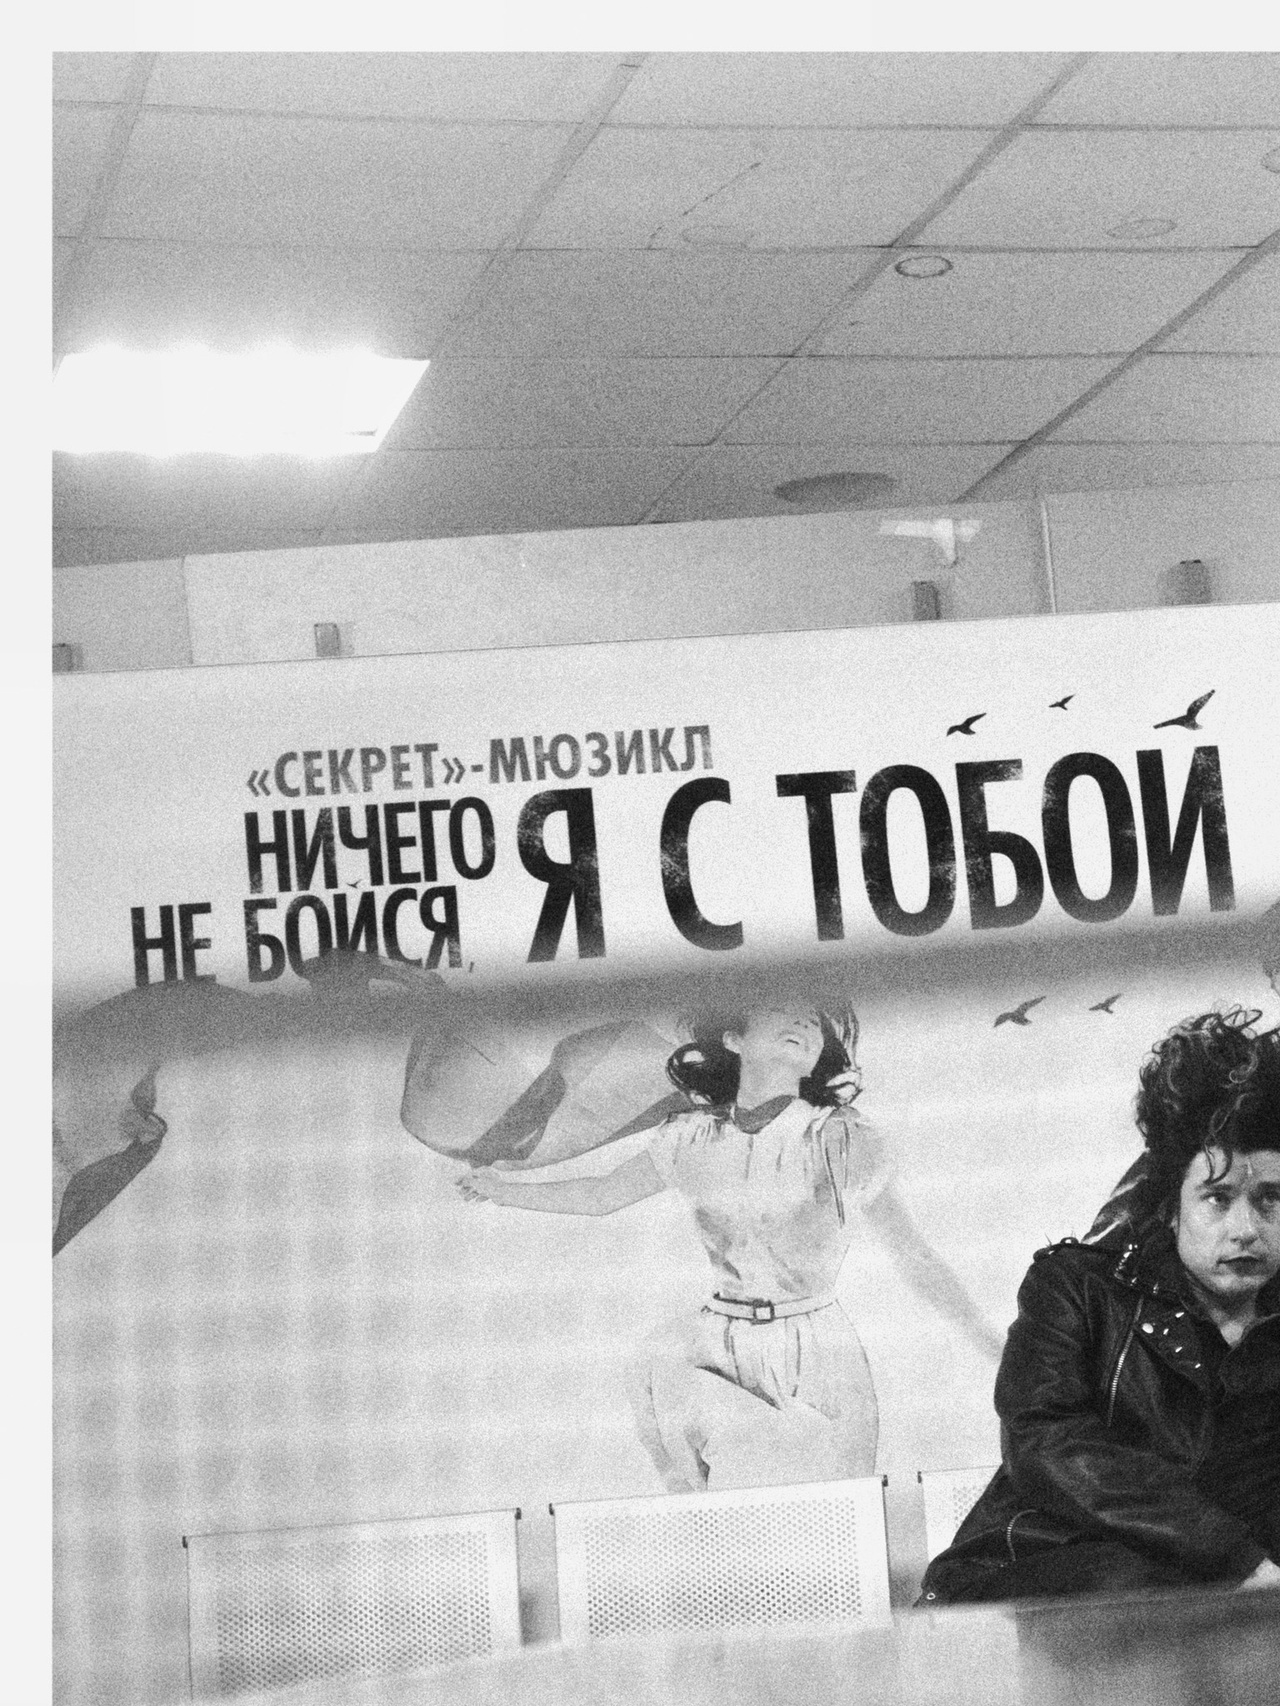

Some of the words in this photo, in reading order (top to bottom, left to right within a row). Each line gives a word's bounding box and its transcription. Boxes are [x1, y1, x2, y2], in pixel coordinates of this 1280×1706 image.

[246, 724, 715, 799] «СЕКРЕТ»-МЮЗИКЛ
[243, 796, 497, 894] НИЧЕГО
[516, 786, 607, 963] Я
[659, 776, 745, 952] С
[775, 690, 1237, 942] ТОБОЙ
[130, 902, 217, 988] НЕ
